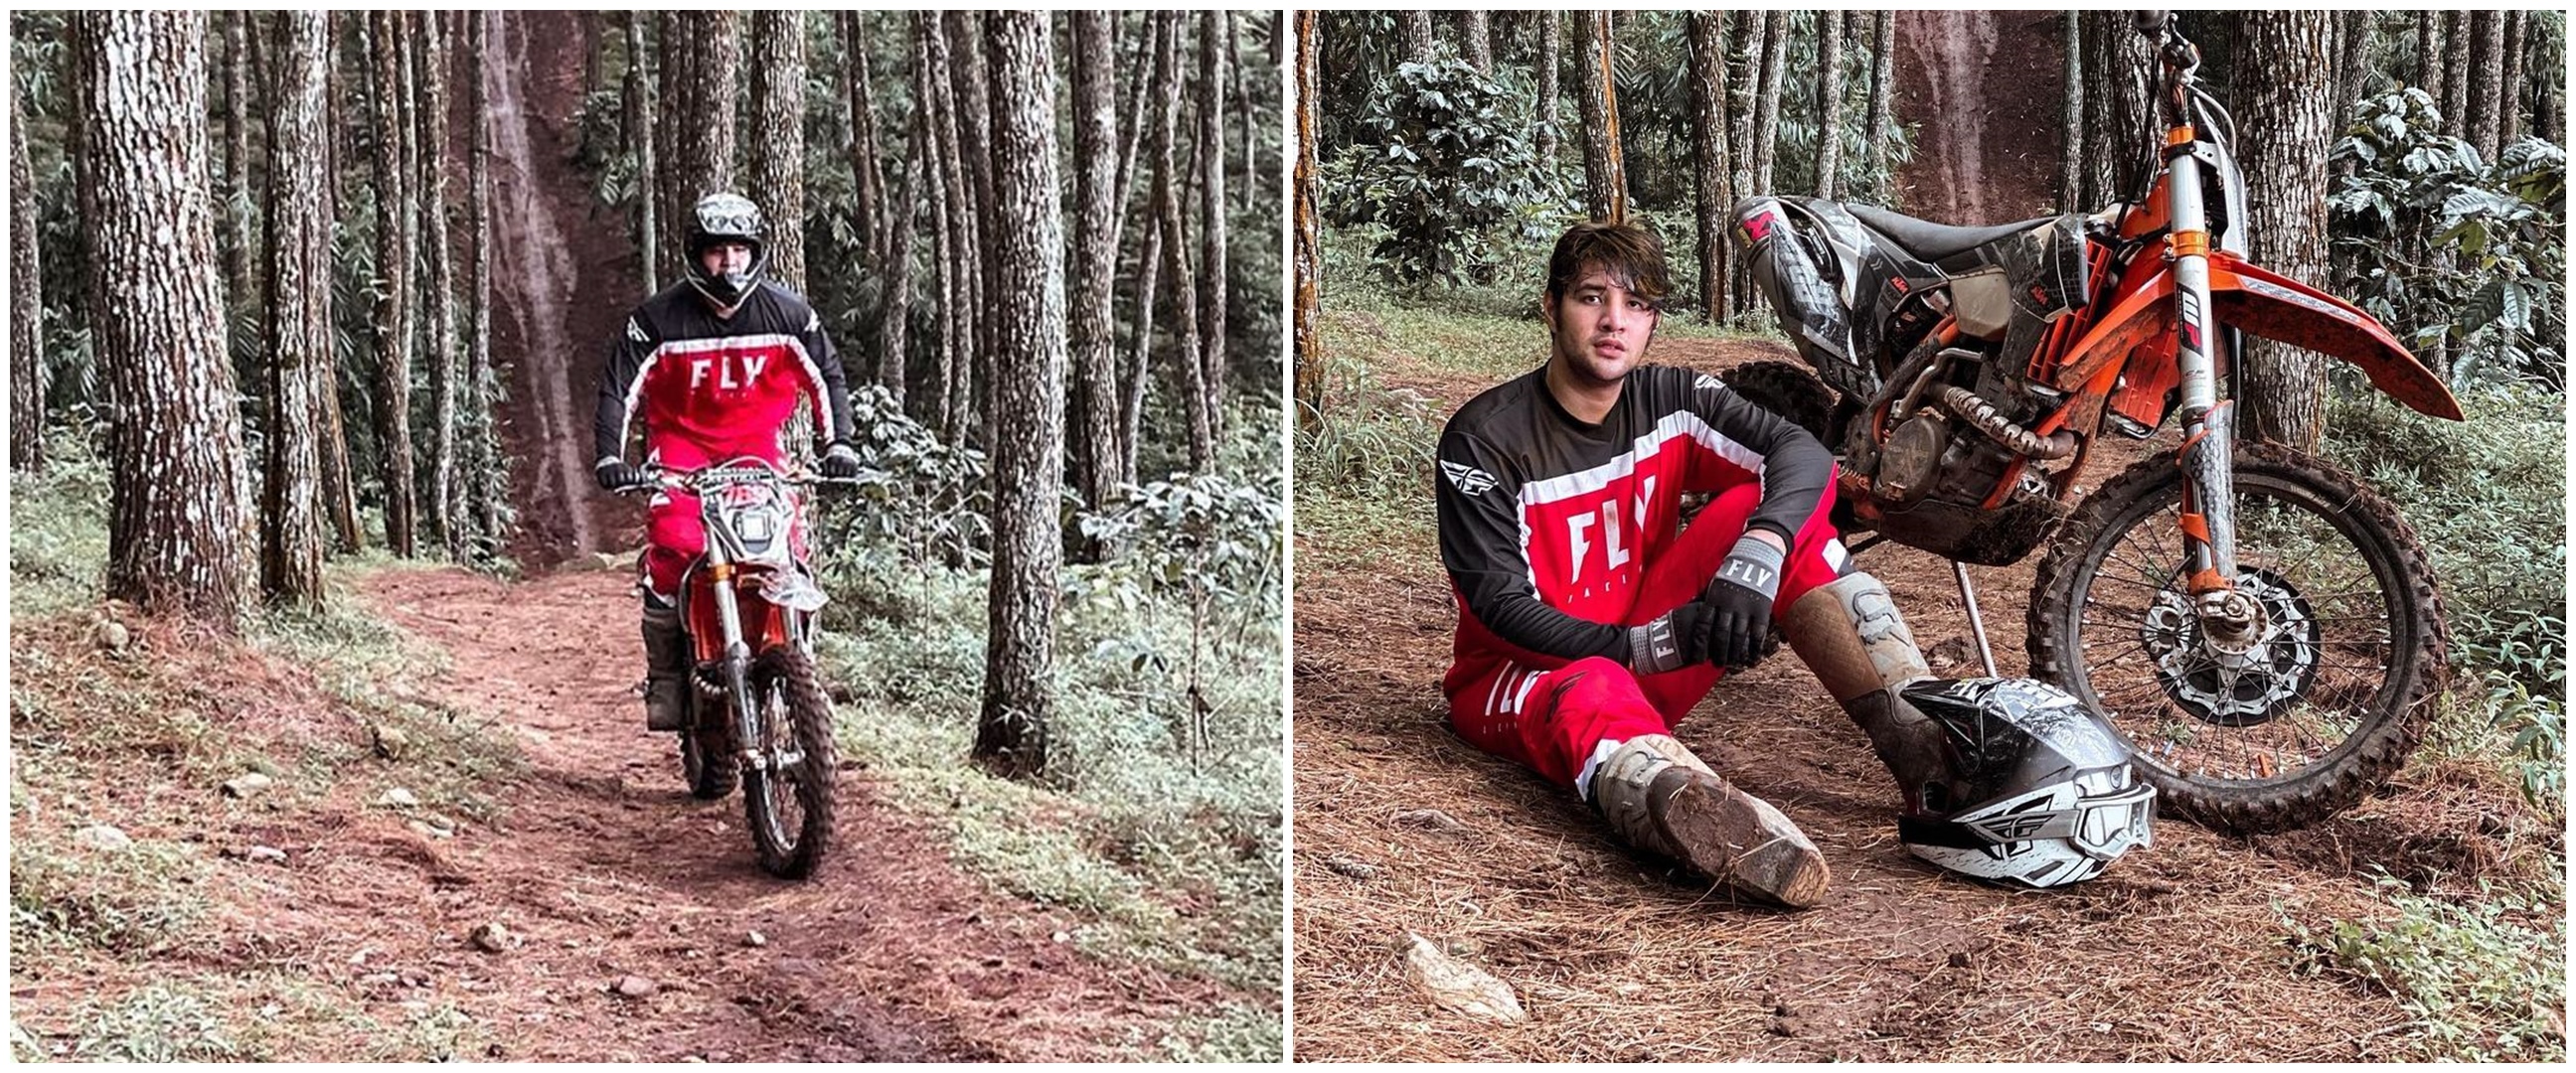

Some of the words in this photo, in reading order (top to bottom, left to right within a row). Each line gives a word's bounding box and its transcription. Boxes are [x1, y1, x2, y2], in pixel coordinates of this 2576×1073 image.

[1890, 276, 1909, 295] KTM
[691, 355, 768, 389] FLY
[1566, 475, 1657, 585] FLY
[1726, 558, 1773, 588] FLY
[1652, 617, 1676, 659] FLY
